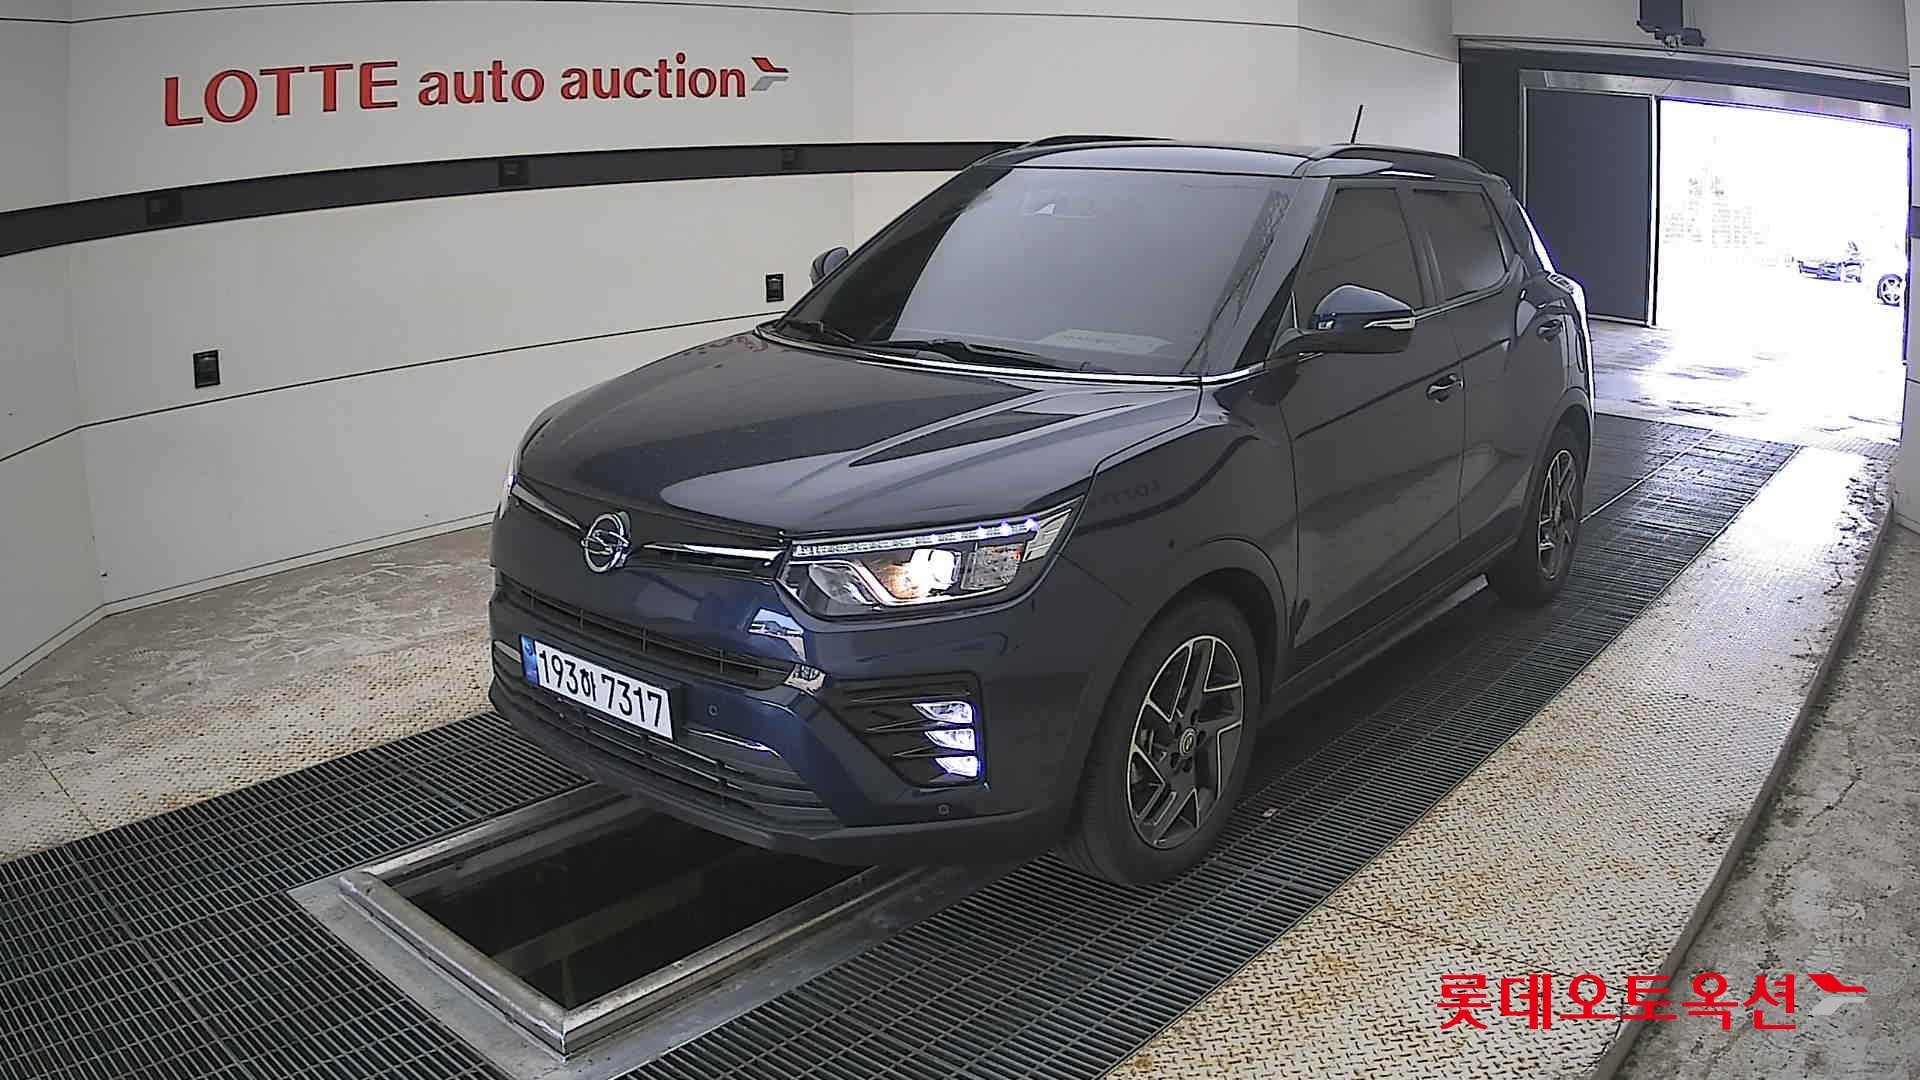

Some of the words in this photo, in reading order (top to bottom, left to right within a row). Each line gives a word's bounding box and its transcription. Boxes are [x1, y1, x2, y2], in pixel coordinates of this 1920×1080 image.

[164, 61, 399, 127] LOTTE
[417, 60, 546, 105] auto
[560, 53, 747, 99] auction
[538, 649, 597, 702] 193하
[600, 673, 663, 727] 7317
